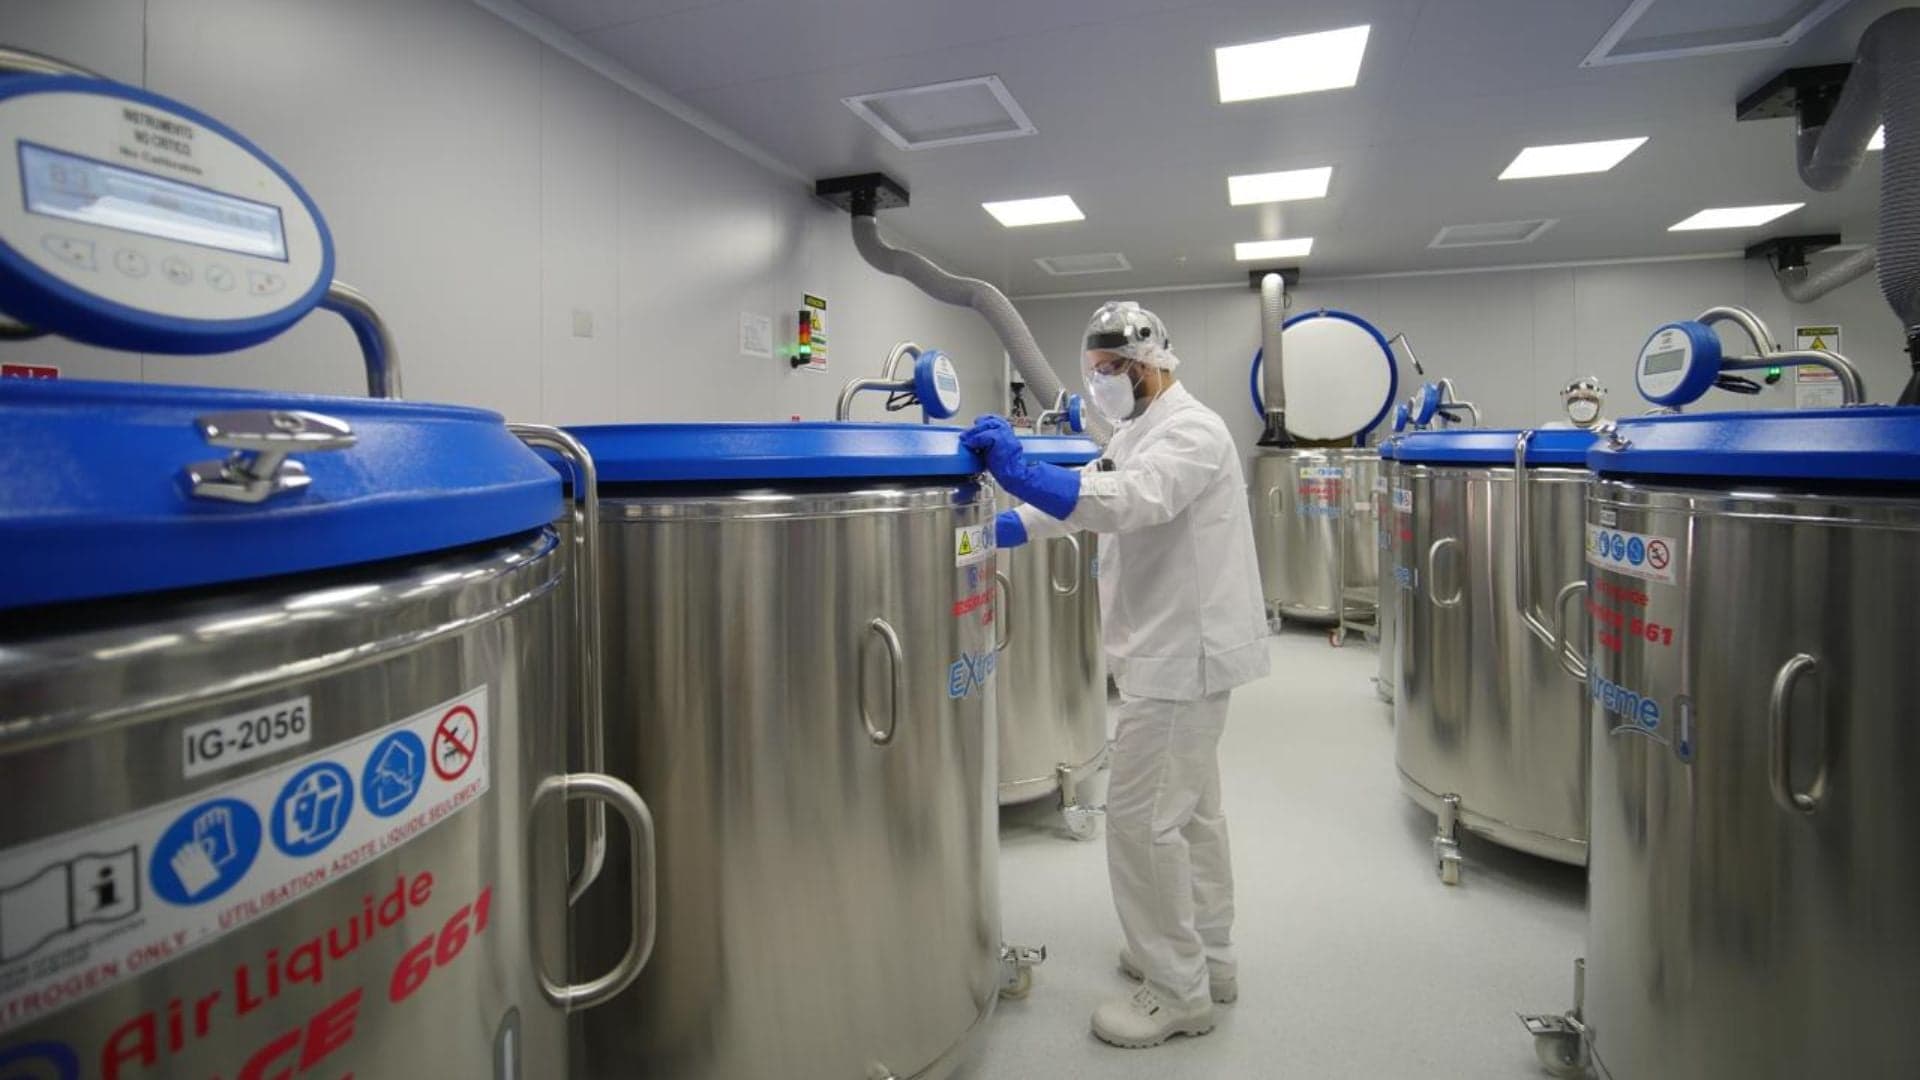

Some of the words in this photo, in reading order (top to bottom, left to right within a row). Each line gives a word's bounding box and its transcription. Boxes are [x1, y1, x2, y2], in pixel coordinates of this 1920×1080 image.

[187, 705, 306, 765] IG-2056
[101, 987, 222, 1080] Air
[233, 869, 434, 1018] Liquide
[126, 929, 188, 971] ONLY
[218, 866, 328, 930] UTILISATION
[388, 883, 493, 1004] 661
